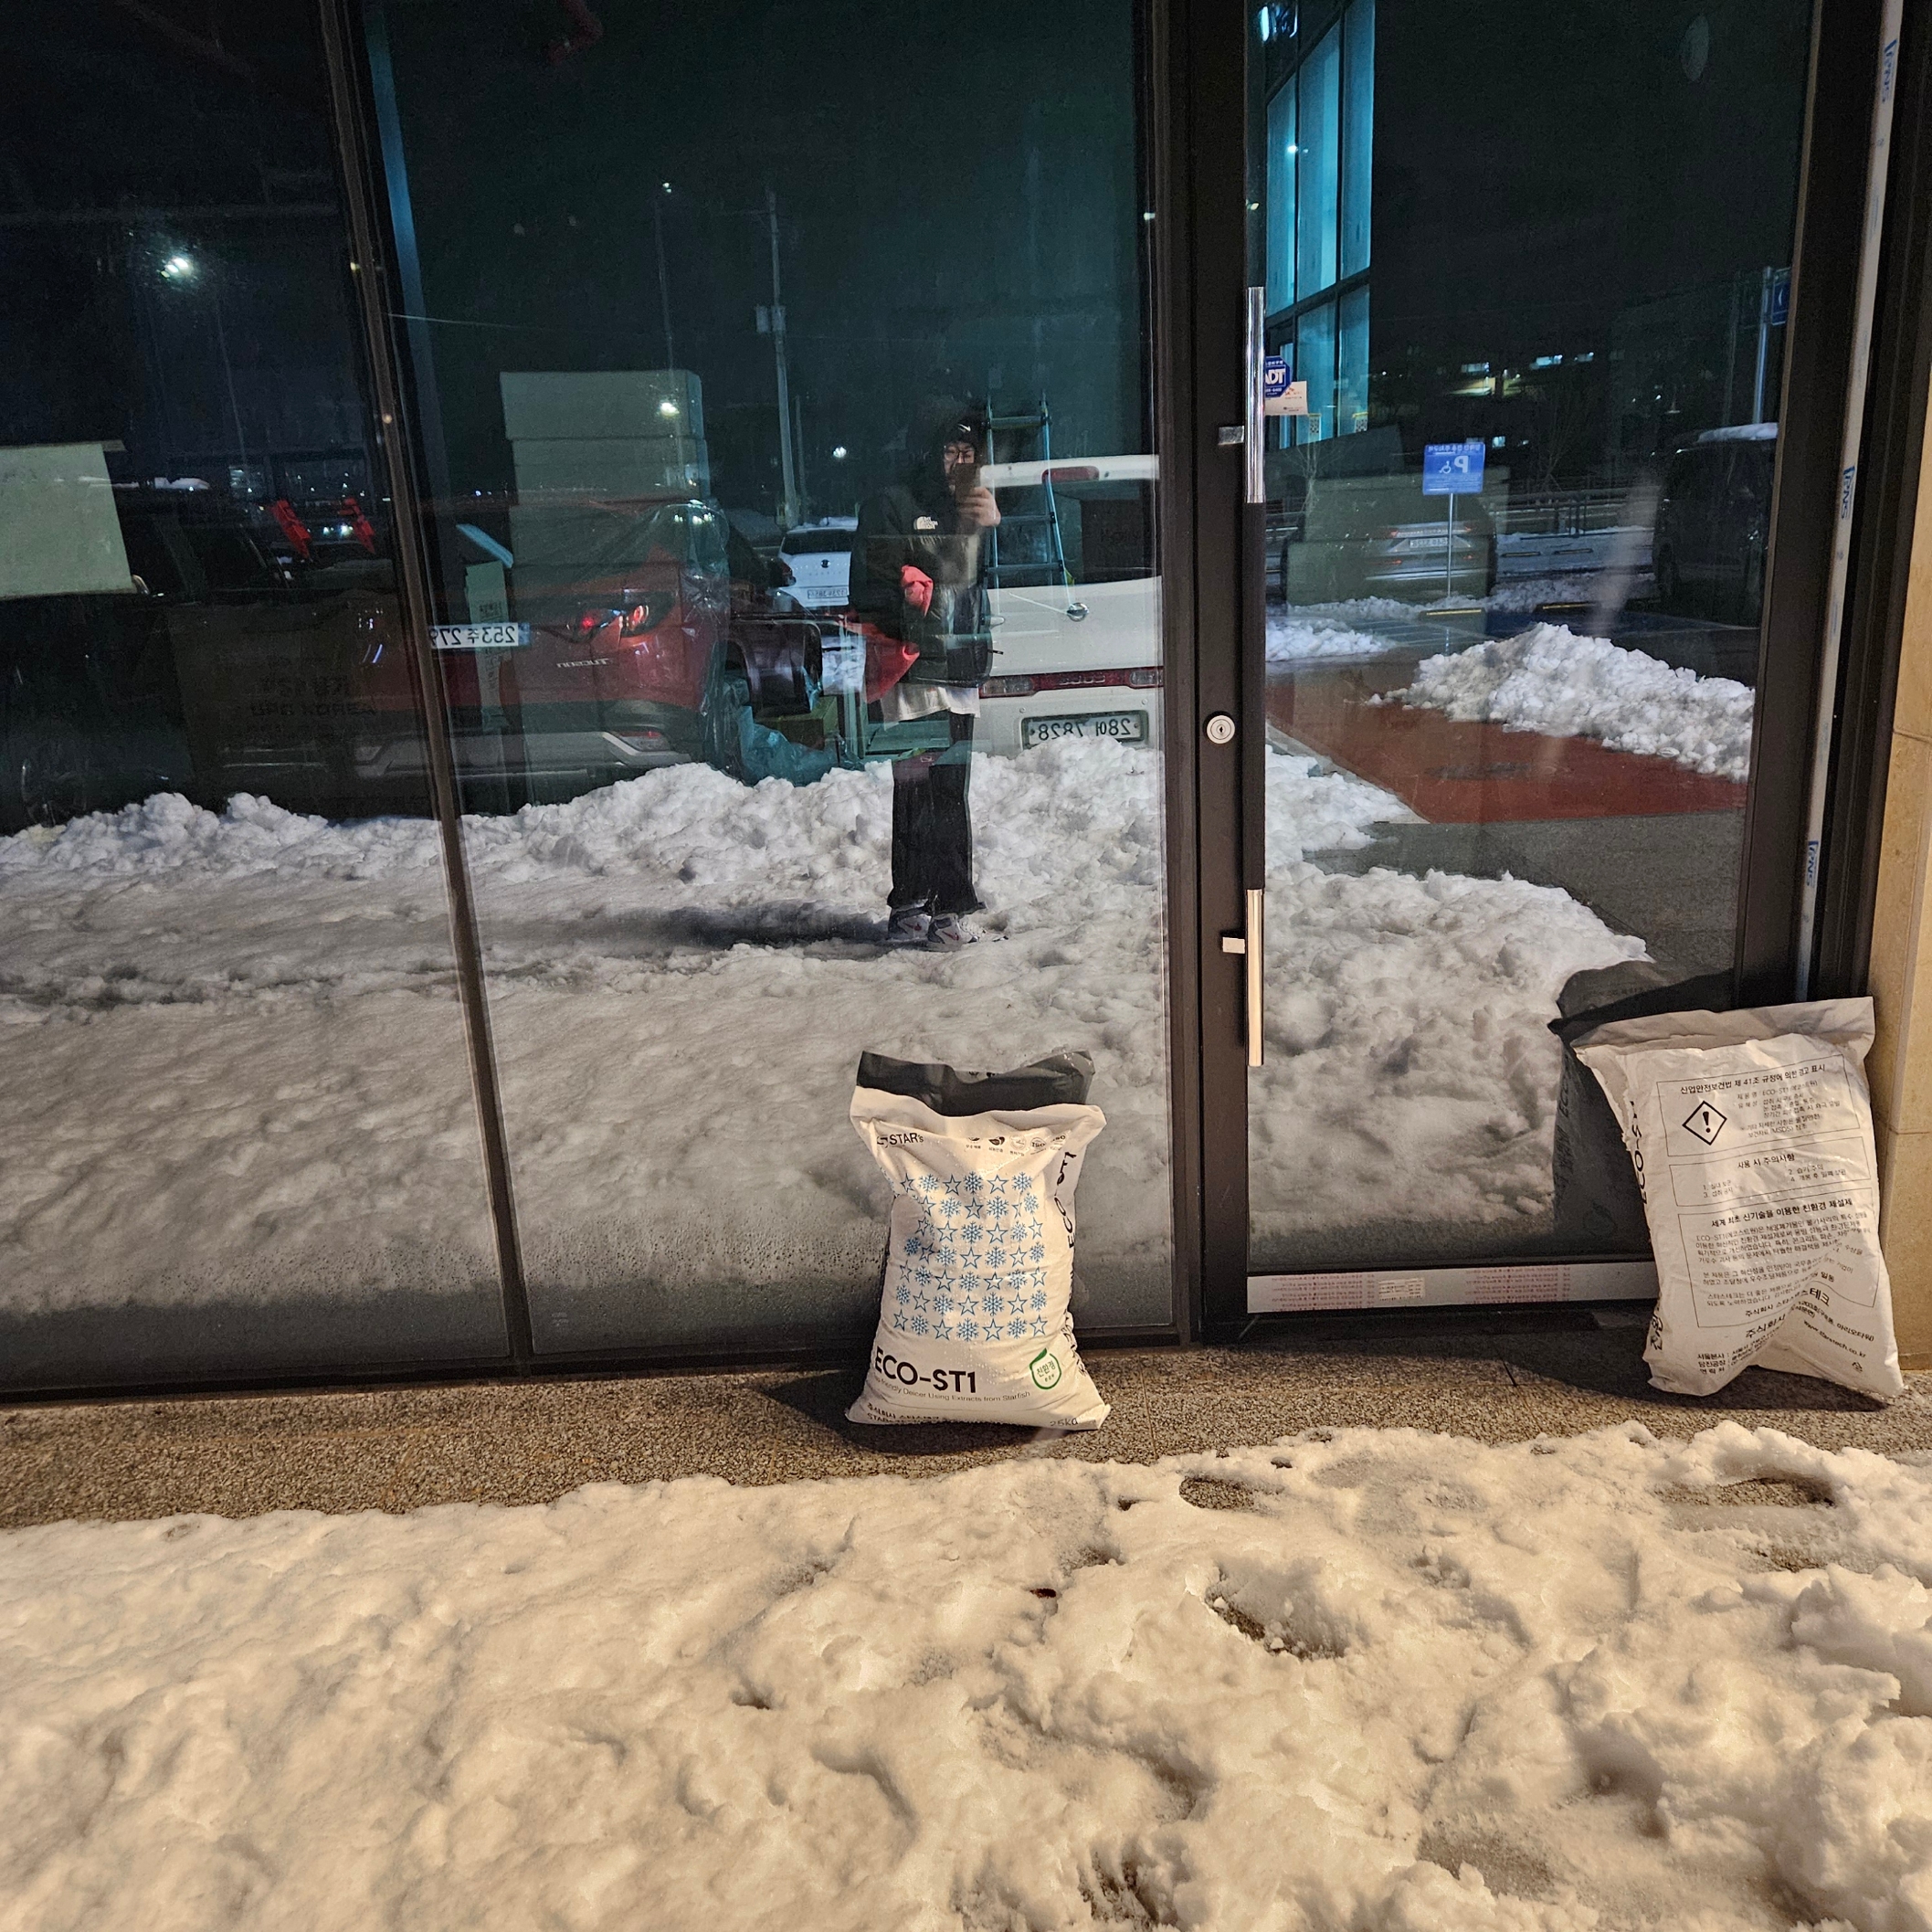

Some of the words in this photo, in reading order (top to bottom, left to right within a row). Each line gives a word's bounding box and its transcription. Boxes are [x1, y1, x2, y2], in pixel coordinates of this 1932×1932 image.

[1734, 1079, 1742, 1087] 제
[1761, 1073, 1783, 1083] 규정에
[1811, 1063, 1825, 1072] 표시
[1776, 1205, 1800, 1217] 이용한
[1802, 1201, 1827, 1213] 친환경
[1829, 1198, 1853, 1208] 제설제
[874, 1346, 977, 1394] ECO-ST1
[1036, 1359, 1057, 1378] 친환경
[928, 1392, 950, 1401] Using
[984, 1394, 1001, 1402] from
[1002, 1390, 1030, 1401] Starfish
